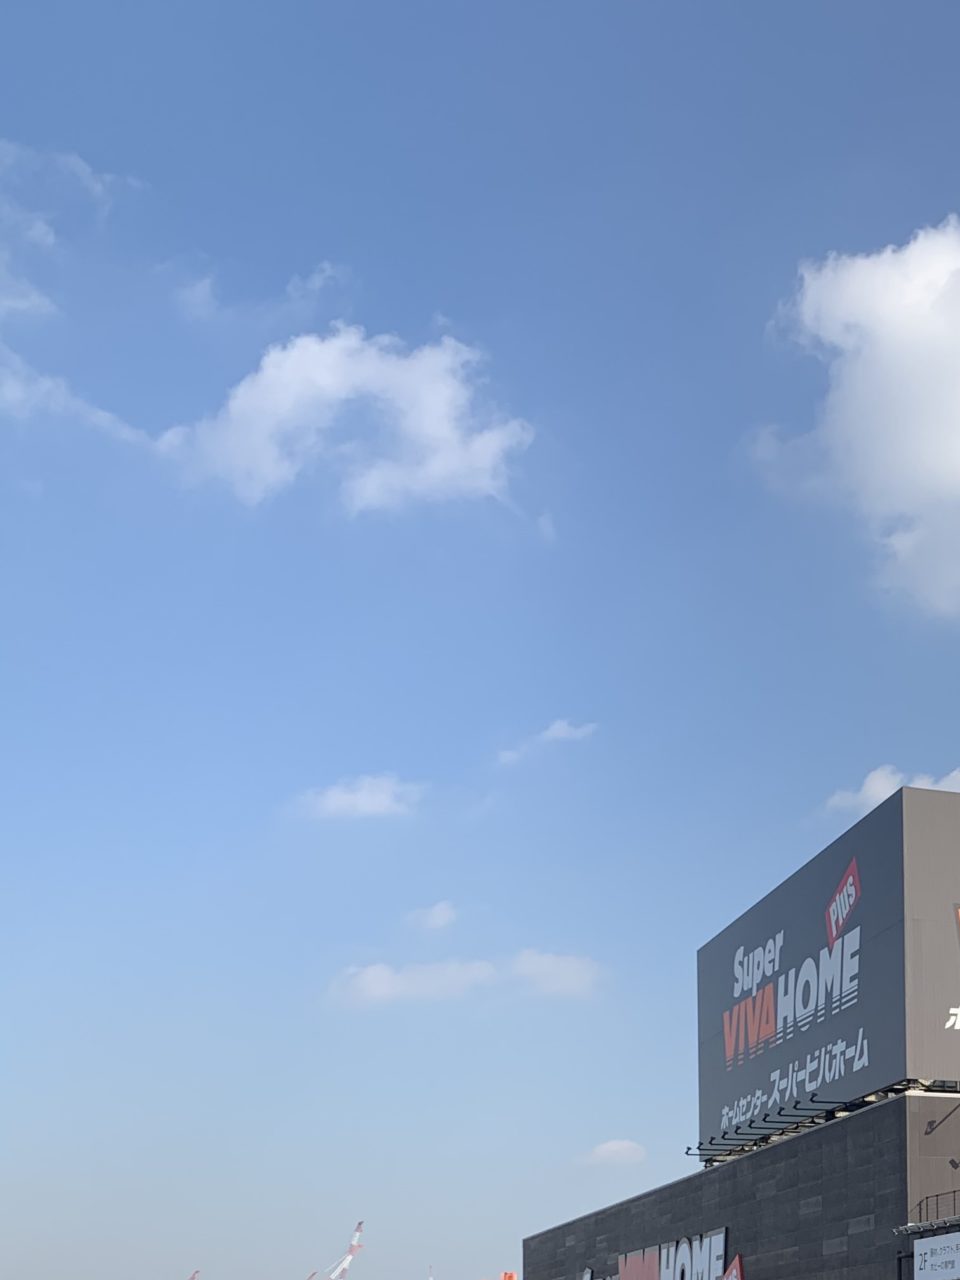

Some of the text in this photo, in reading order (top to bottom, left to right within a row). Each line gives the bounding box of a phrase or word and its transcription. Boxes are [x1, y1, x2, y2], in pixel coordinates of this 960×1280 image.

[829, 875, 856, 938] Plus
[733, 929, 784, 997] Super
[918, 1252, 928, 1271] 2F
